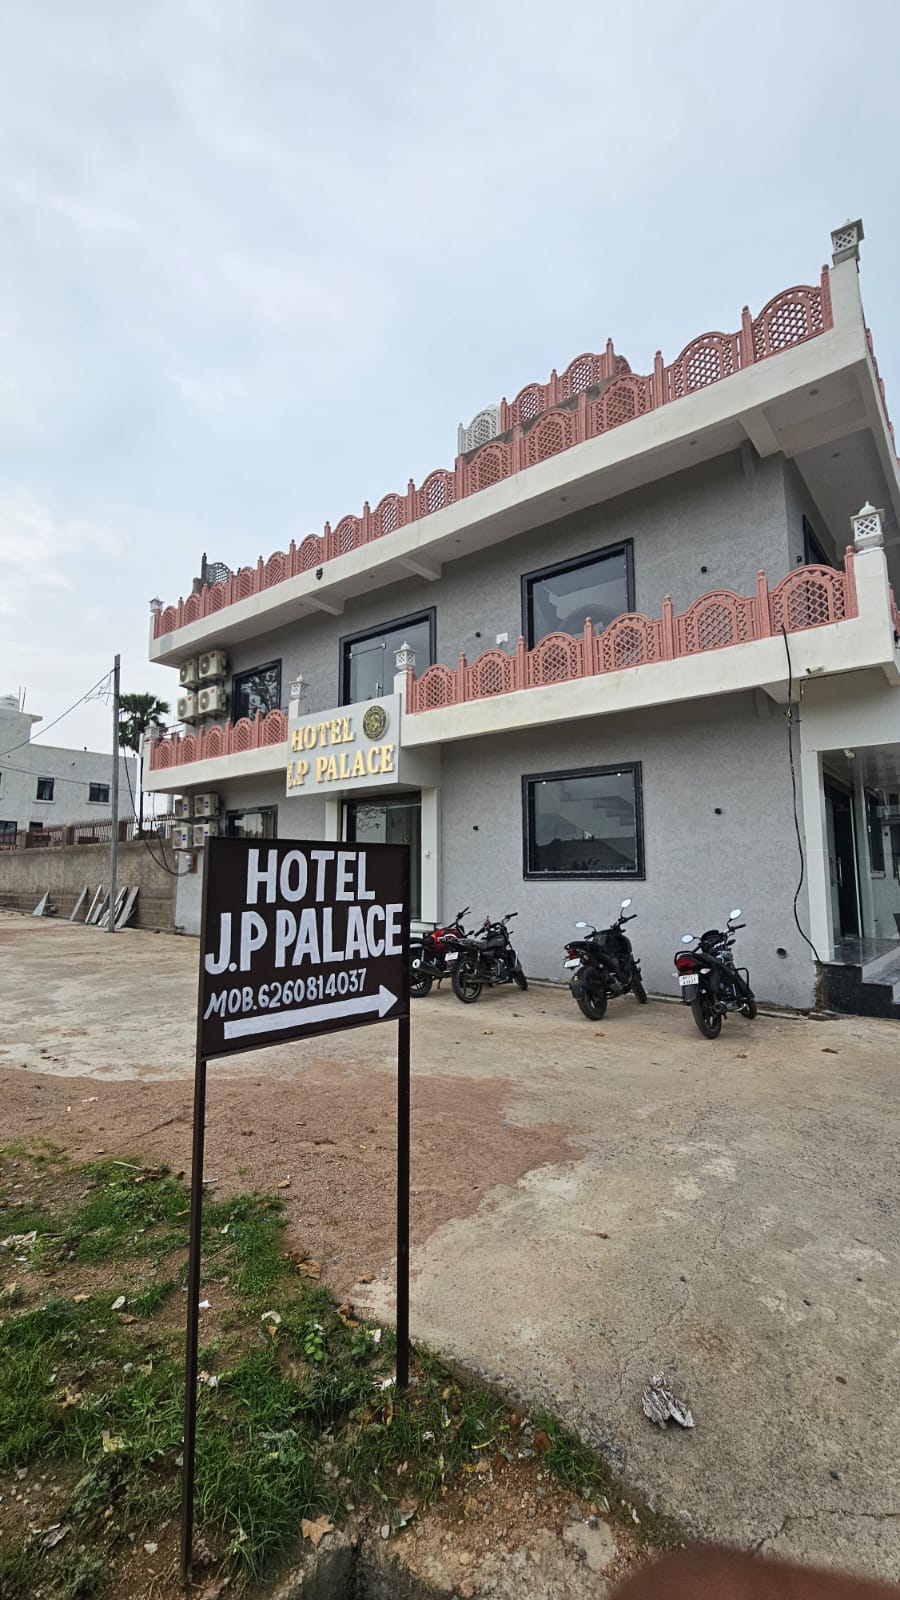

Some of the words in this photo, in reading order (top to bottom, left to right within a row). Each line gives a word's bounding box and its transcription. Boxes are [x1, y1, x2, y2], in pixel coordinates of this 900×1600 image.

[291, 716, 354, 752] HOTEL
[316, 744, 395, 783] PALACE
[246, 848, 376, 904] HOTEL
[204, 910, 268, 975] J.P
[275, 903, 403, 968] PALACE
